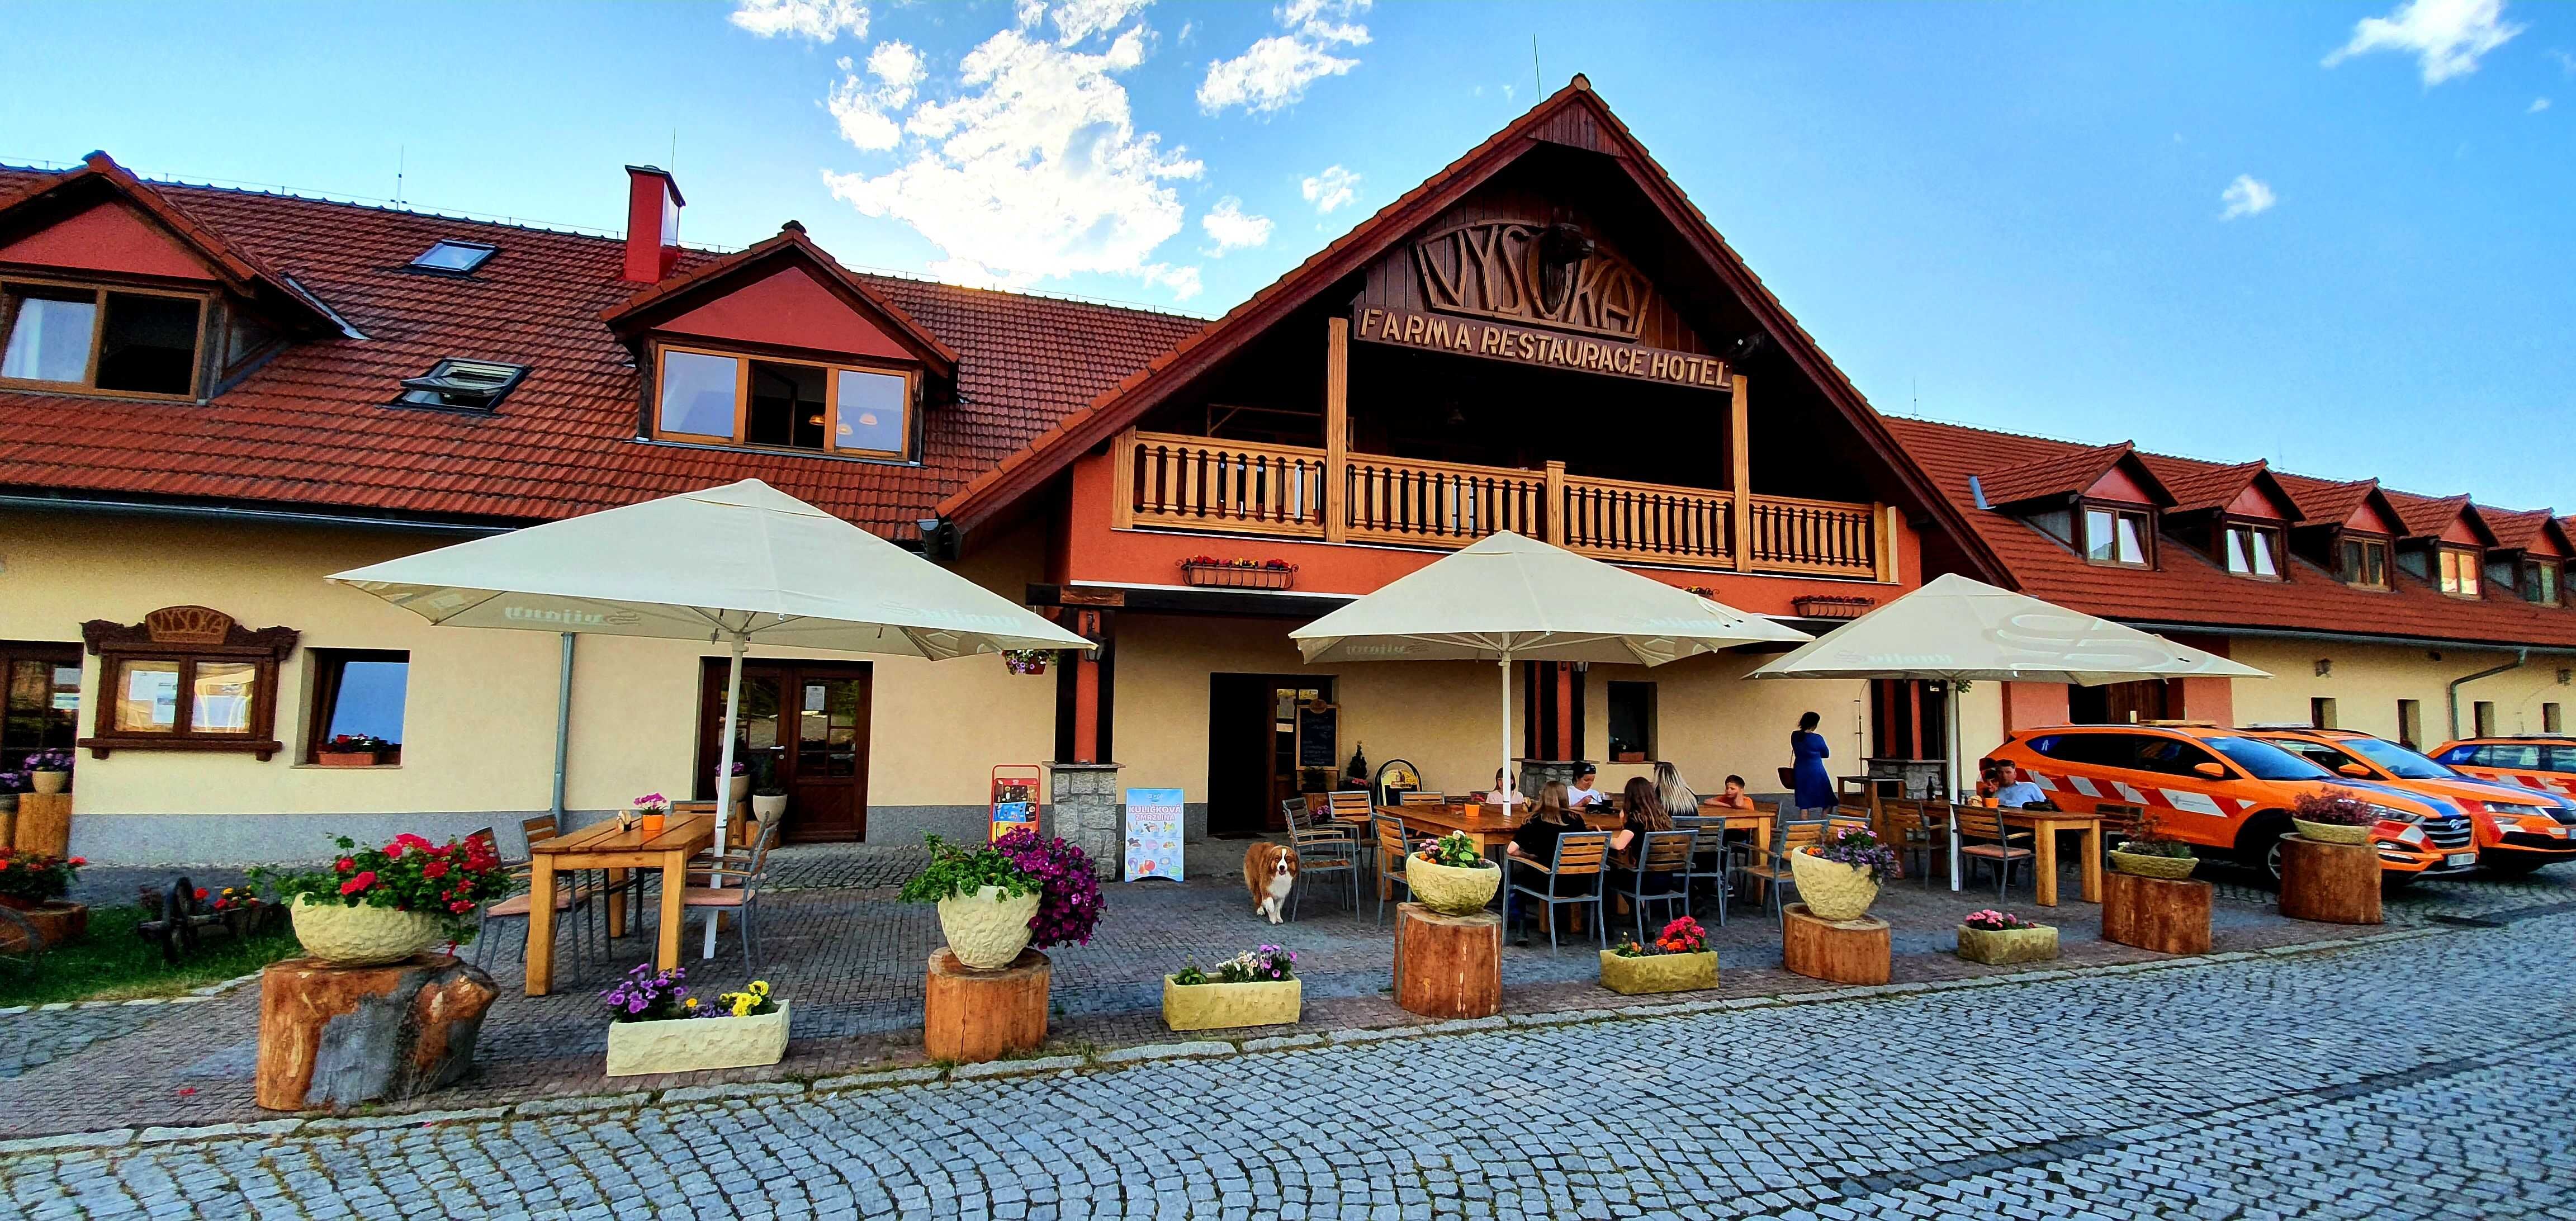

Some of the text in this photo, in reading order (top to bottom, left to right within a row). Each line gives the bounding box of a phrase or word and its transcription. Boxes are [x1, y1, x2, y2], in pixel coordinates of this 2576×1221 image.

[1360, 308, 1731, 388] FARMA RESTAURACE HOTEL
[1128, 803, 1181, 813] KULIČKOVÁ
